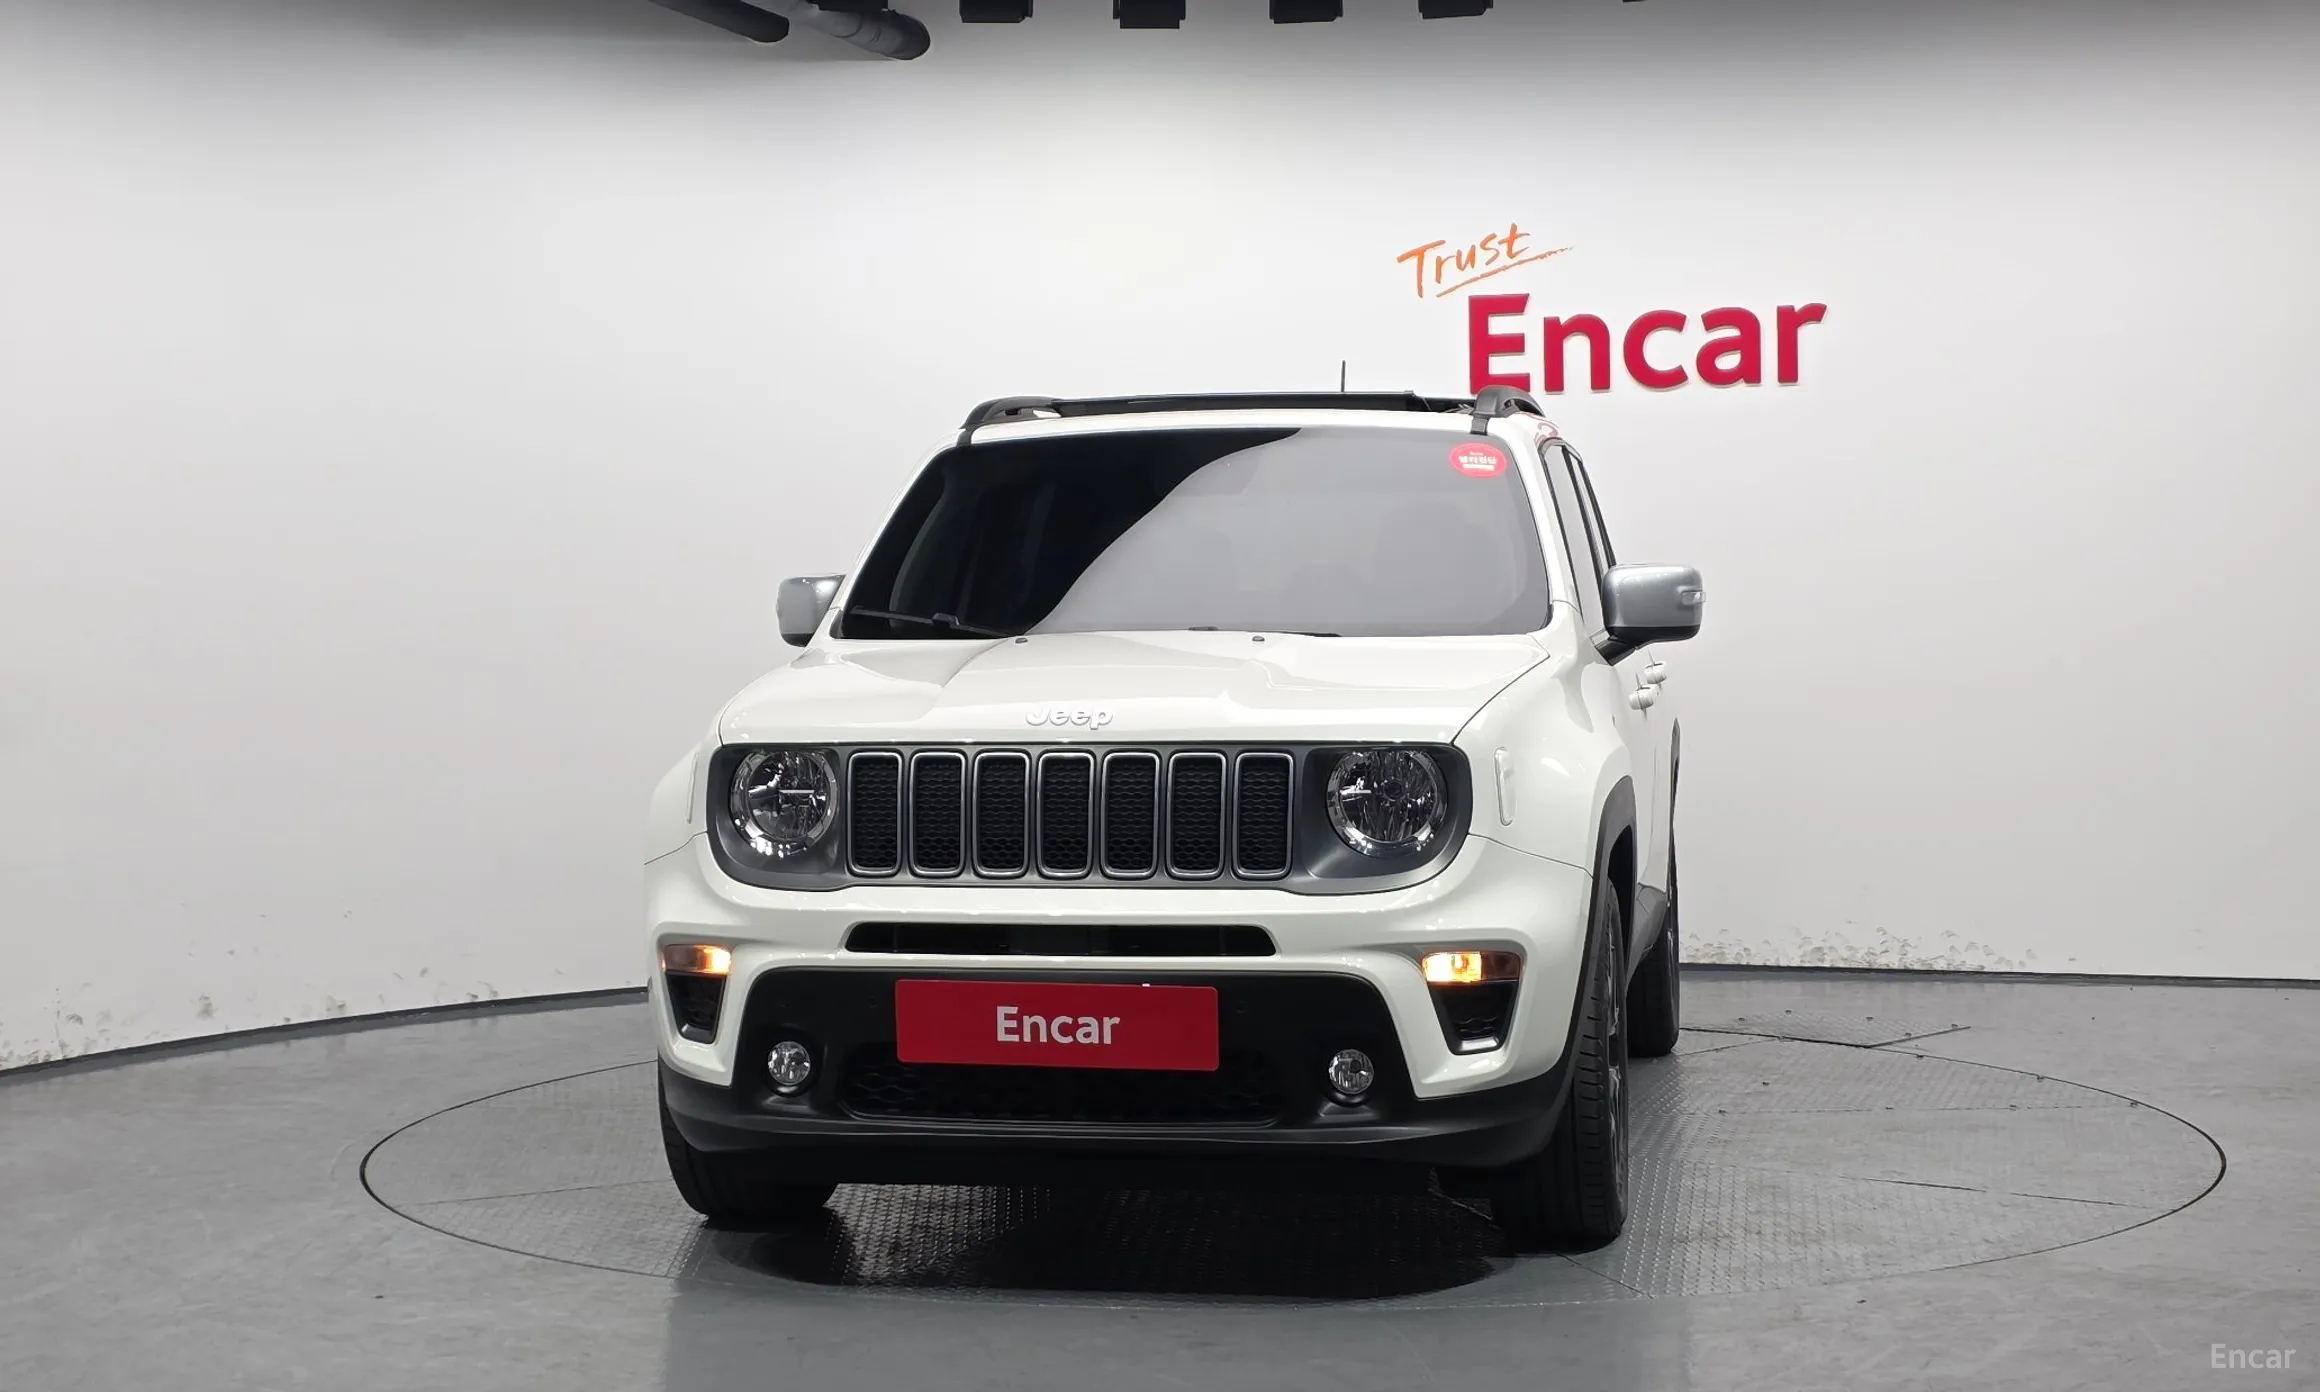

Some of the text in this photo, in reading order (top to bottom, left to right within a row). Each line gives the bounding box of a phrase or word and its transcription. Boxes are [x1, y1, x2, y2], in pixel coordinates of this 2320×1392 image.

[1396, 222, 1531, 299] Trust
[1468, 293, 1828, 395] Encar
[1025, 704, 1114, 731] Jeep
[996, 1005, 1120, 1045] Encar
